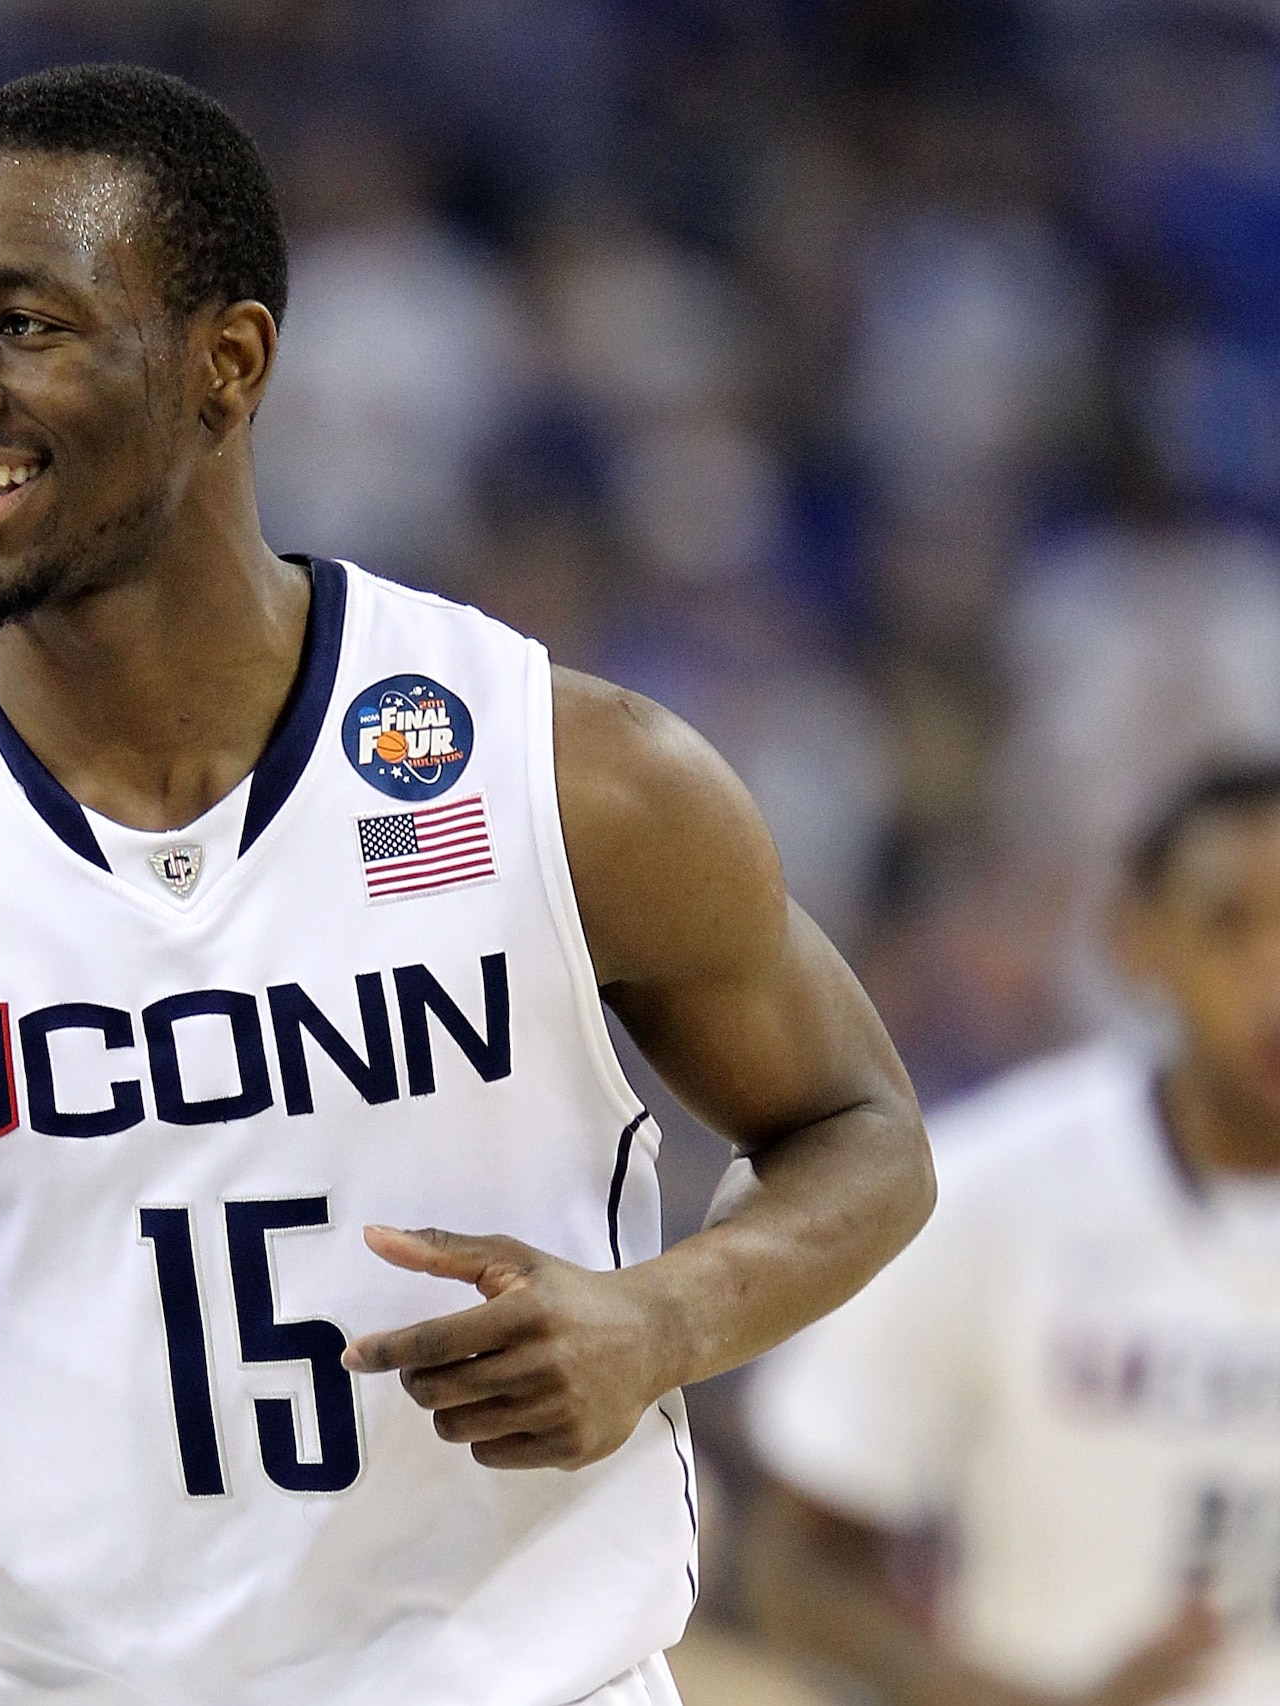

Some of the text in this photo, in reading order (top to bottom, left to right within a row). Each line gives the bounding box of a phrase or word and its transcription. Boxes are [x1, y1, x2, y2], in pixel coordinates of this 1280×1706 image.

[418, 699, 445, 709] 2011
[381, 706, 450, 732] FINAL
[407, 751, 464, 768] HOUSTON
[135, 1188, 367, 1498] 15
